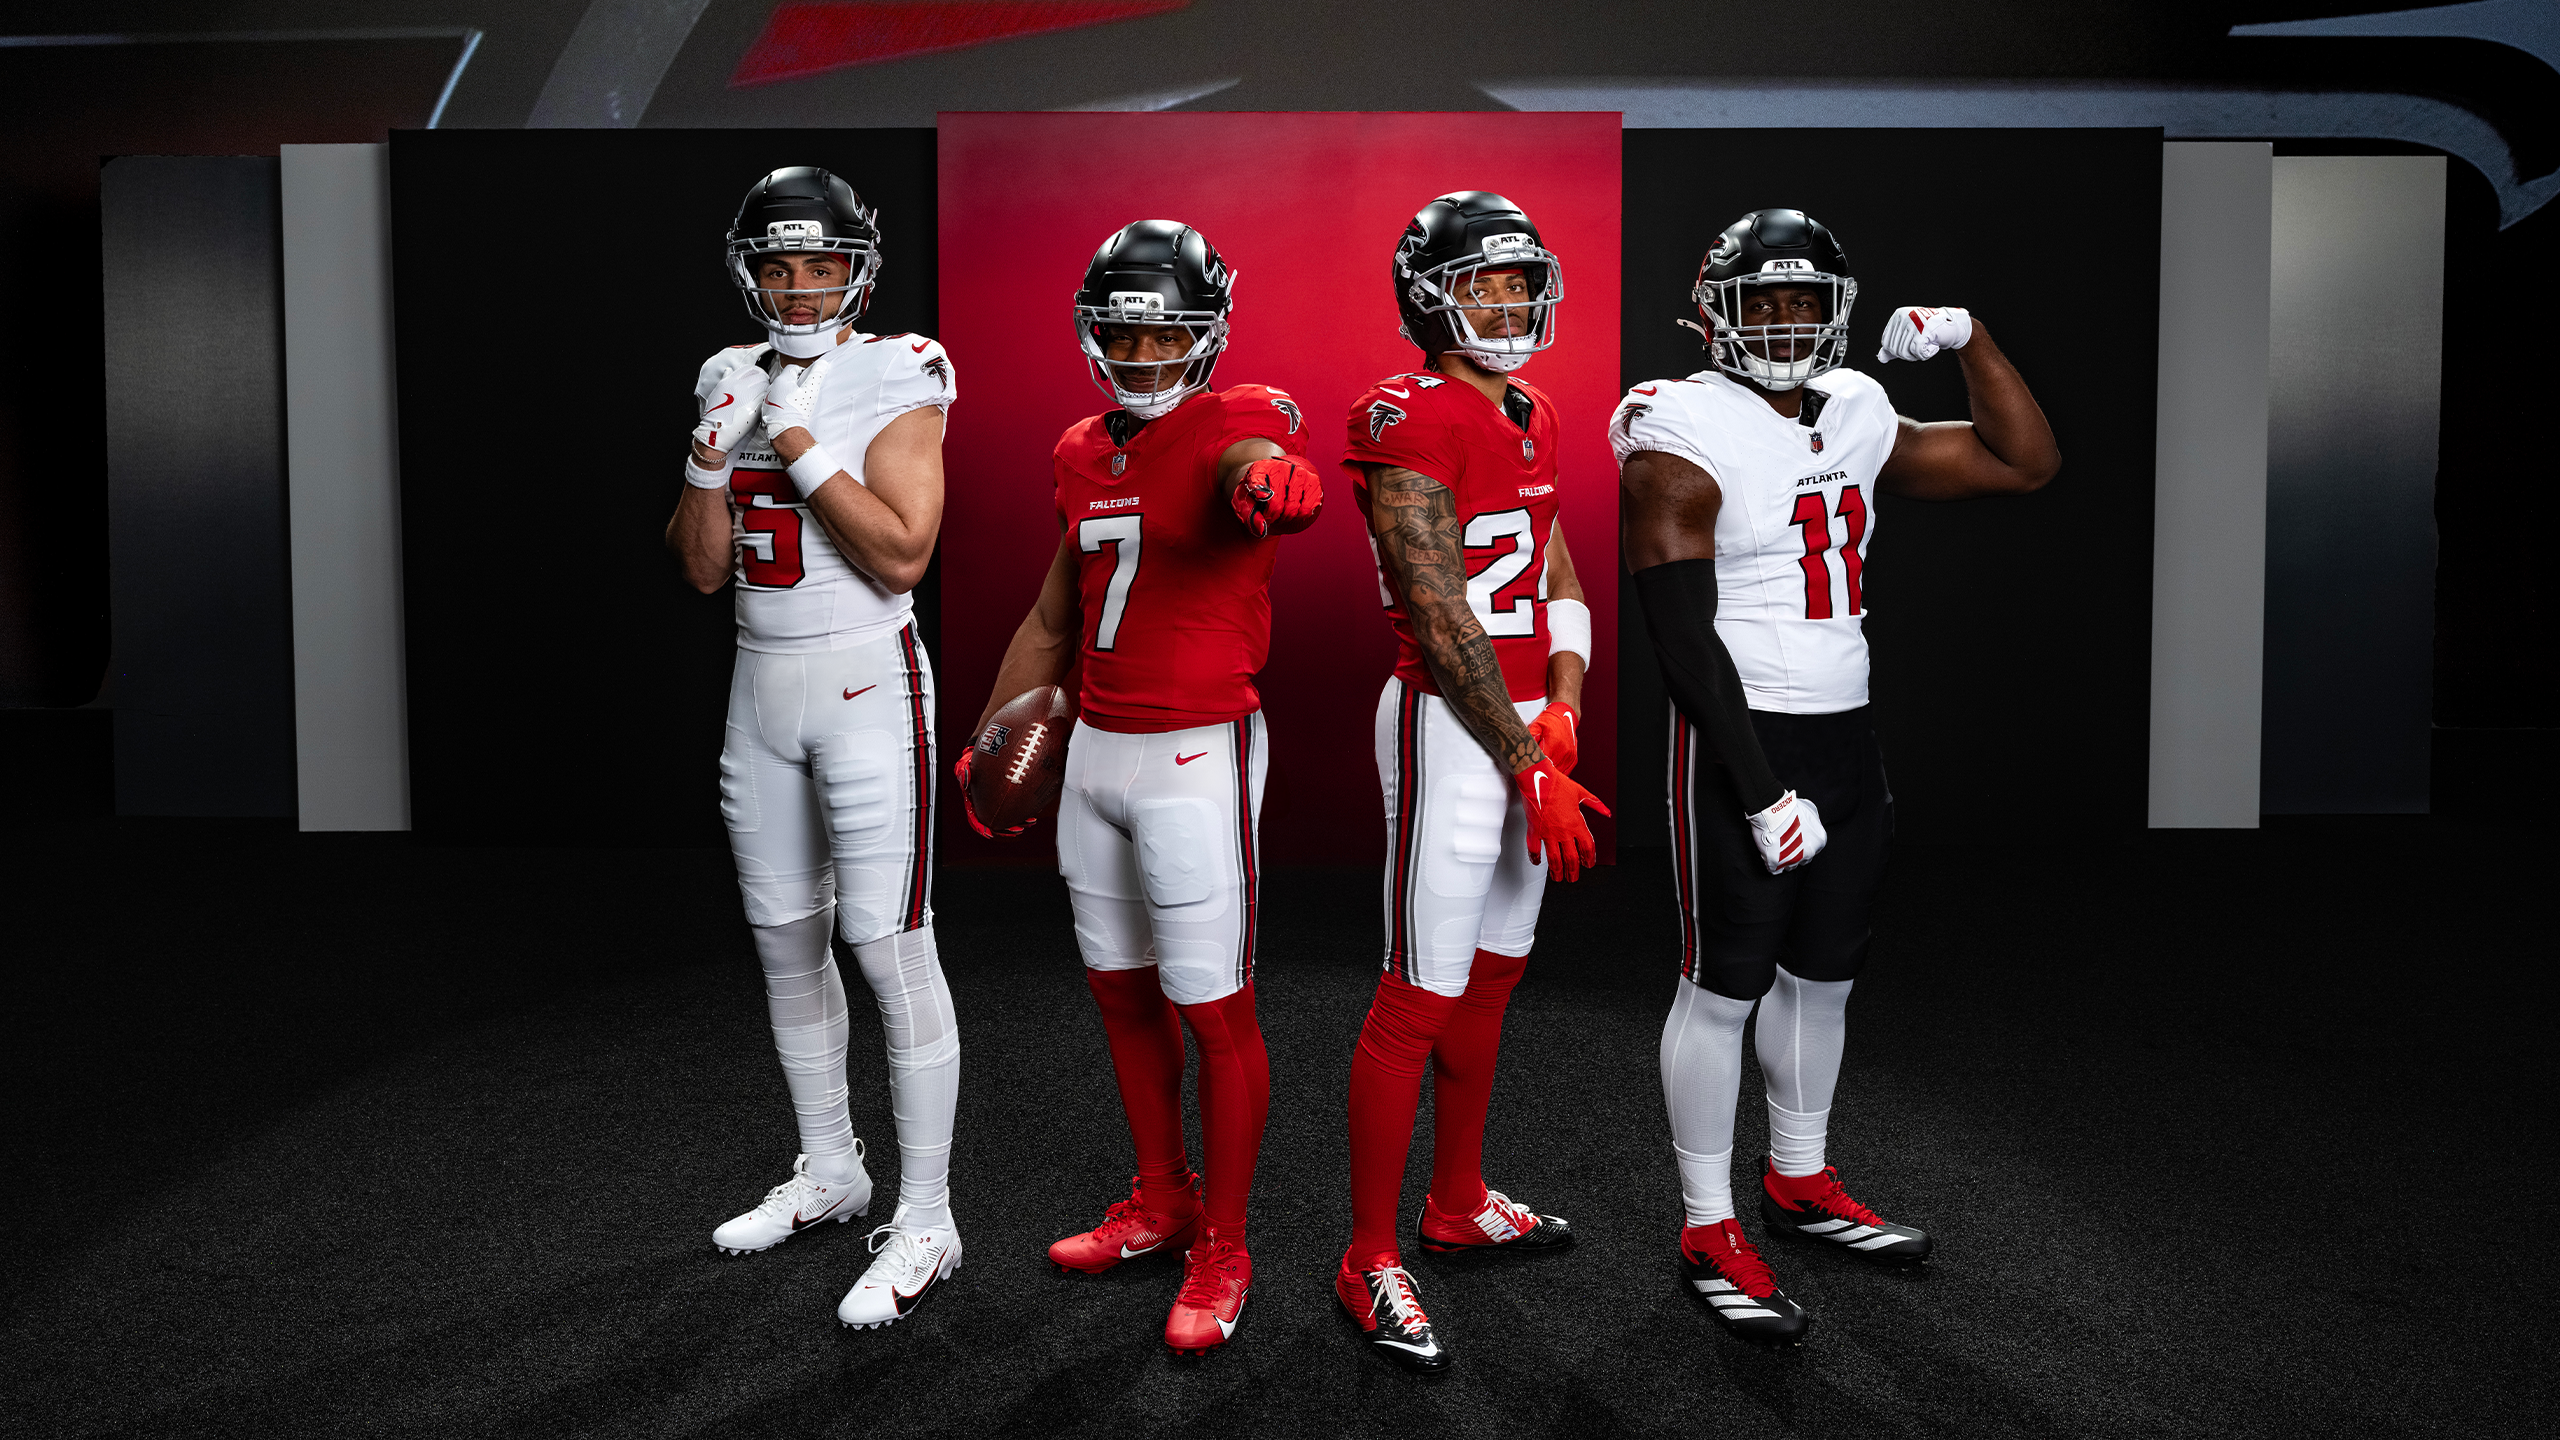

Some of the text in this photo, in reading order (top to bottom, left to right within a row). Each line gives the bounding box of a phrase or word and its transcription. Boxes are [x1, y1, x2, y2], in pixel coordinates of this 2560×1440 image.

[783, 223, 805, 232] ATL
[1499, 235, 1520, 244] ATL
[1772, 260, 1804, 271] ATL
[1124, 296, 1146, 305] ATL
[739, 452, 780, 463] ATLANT
[1796, 470, 1849, 488] ATLANTA
[1517, 484, 1554, 498] FALCONS
[1089, 496, 1140, 511] FALCONS
[730, 467, 810, 589] 5
[1789, 484, 1868, 620] 11
[1078, 512, 1145, 653] 7
[1469, 649, 1493, 669] OVER
[1473, 1206, 1521, 1243] NIKE
